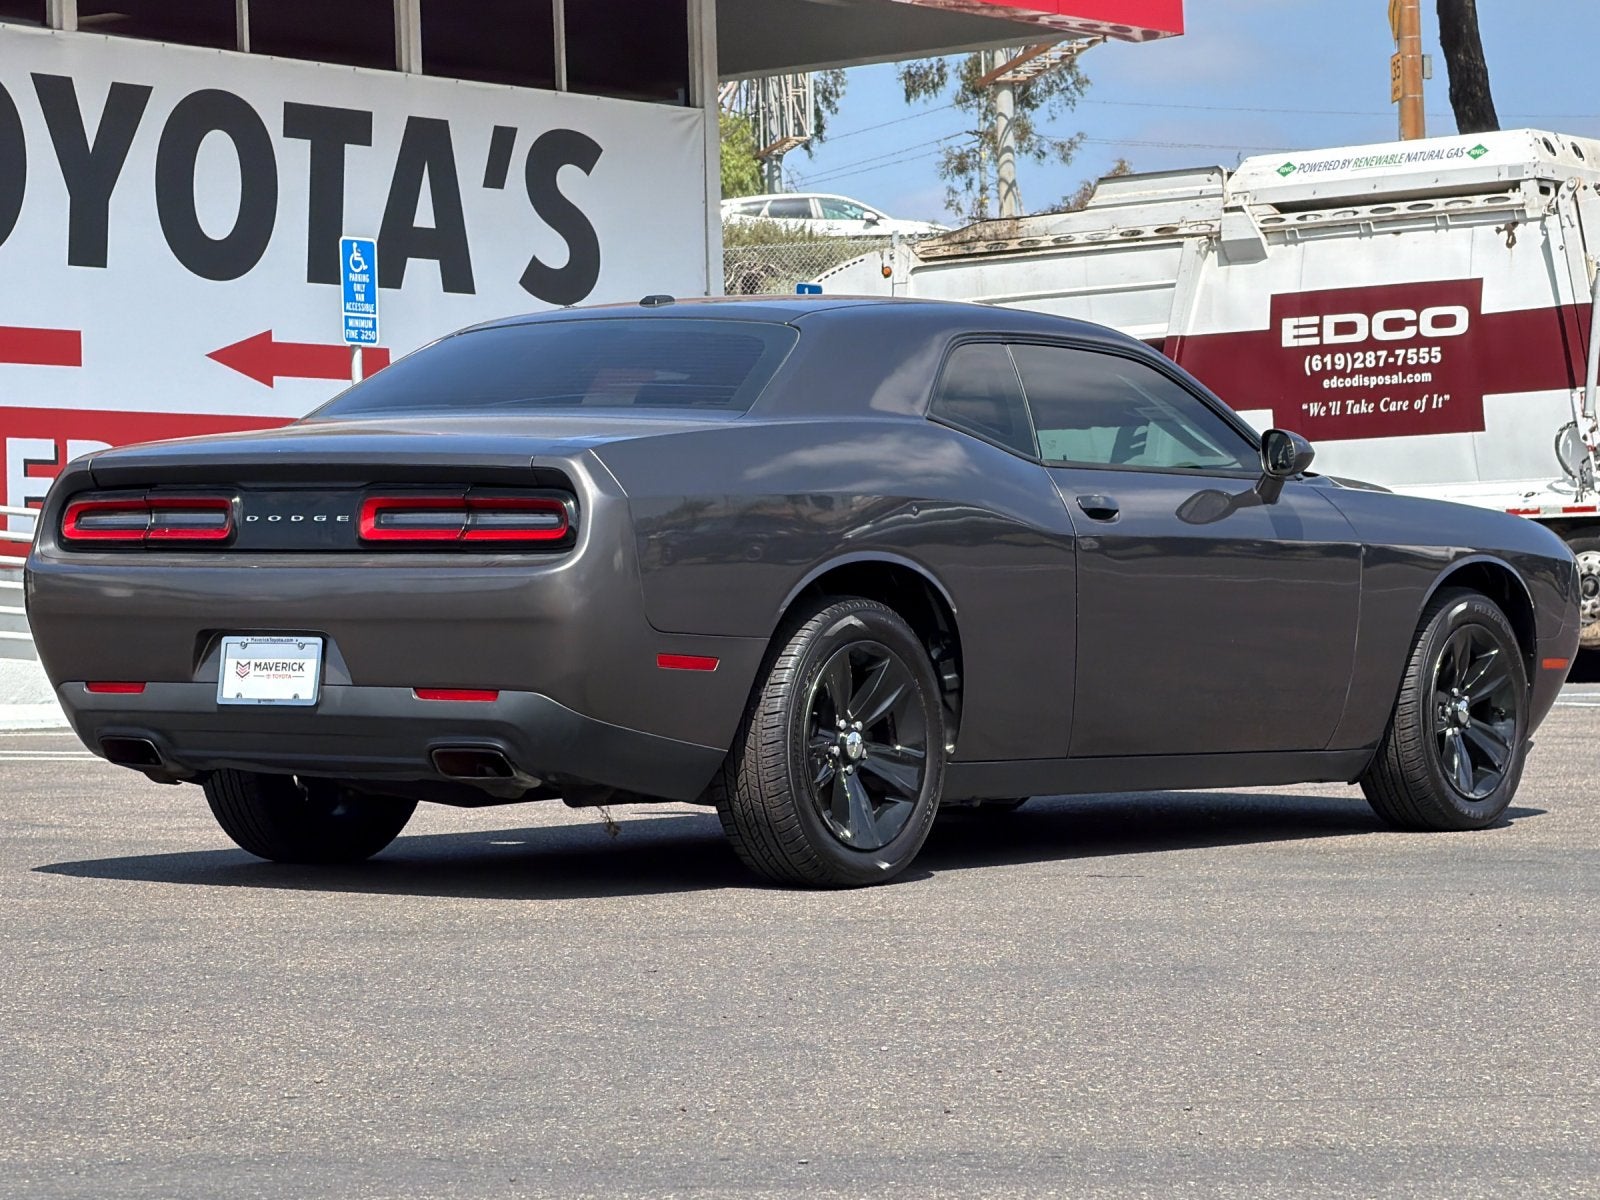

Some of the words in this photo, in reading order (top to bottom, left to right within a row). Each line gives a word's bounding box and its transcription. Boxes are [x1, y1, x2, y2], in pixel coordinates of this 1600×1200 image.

[1470, 147, 1486, 156] RNG
[1297, 160, 1341, 174] POWERED
[1340, 158, 1353, 169] BY
[1353, 153, 1406, 168] RENEWABLE
[1405, 149, 1444, 163] NATURAL
[1447, 147, 1466, 159] GAS
[1279, 164, 1295, 173] RNG
[0, 72, 604, 306] YOTA'S
[349, 272, 369, 283] PARKING
[353, 283, 366, 292] ONLY
[355, 293, 365, 302] VAN
[345, 302, 375, 313] ACCESSIBLE
[348, 318, 373, 329] MINIMUM
[1281, 305, 1469, 348] EDCO
[345, 328, 359, 339] FINE
[1304, 346, 1442, 376] (619)287-7555
[1322, 371, 1432, 389] edcodisposal.com
[1345, 398, 1375, 415] Take
[1379, 396, 1409, 413] Care
[1413, 395, 1427, 413] of
[246, 514, 350, 522] DODGE
[254, 661, 305, 672] MAVERICK
